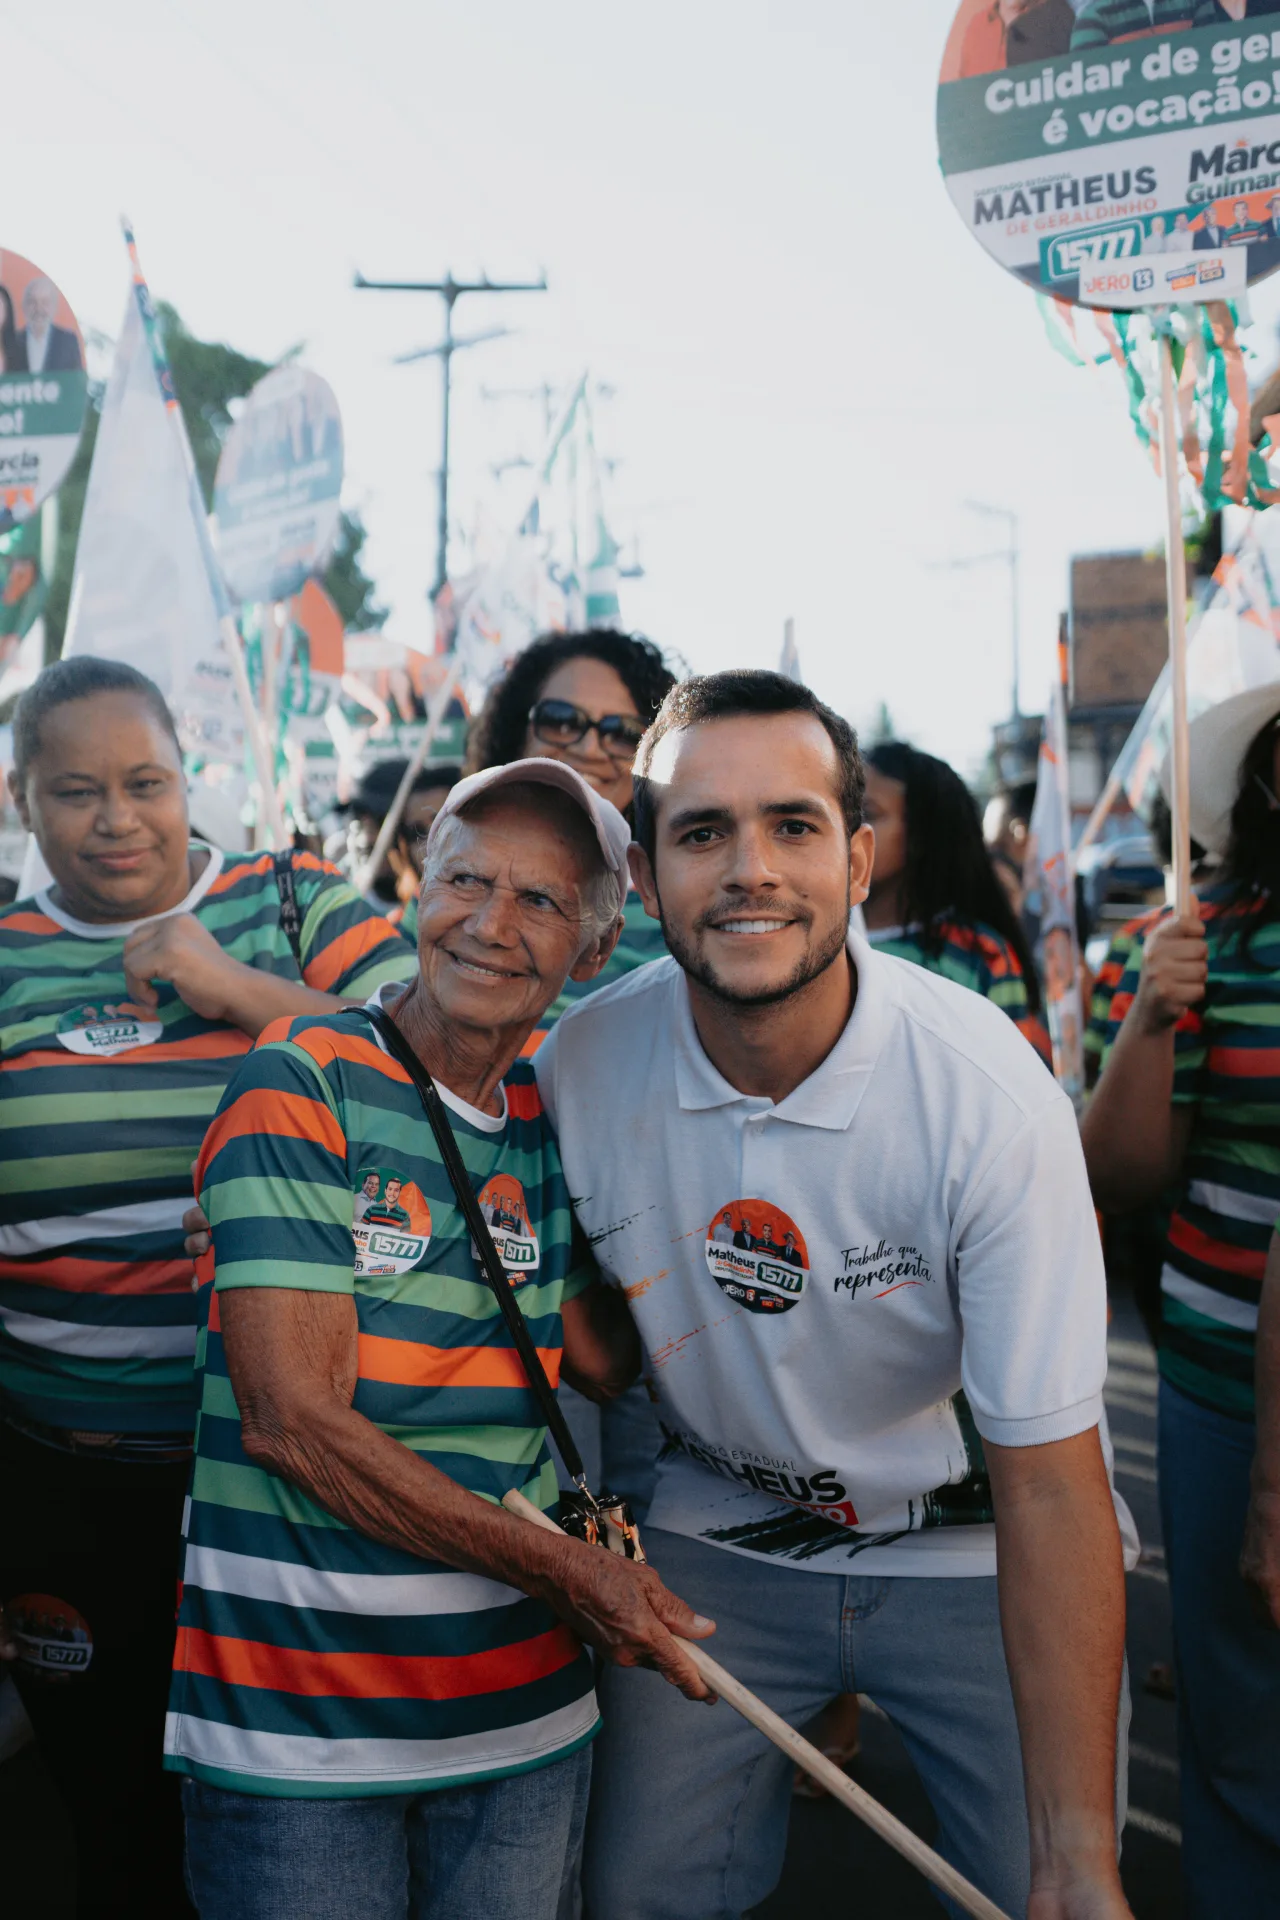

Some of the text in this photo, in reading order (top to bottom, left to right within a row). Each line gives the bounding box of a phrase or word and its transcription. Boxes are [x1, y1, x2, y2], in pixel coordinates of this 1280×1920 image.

[985, 58, 1131, 113] Cuidar
[1141, 43, 1199, 80] de
[1042, 70, 1280, 144] é vocação!
[974, 166, 1158, 225] MATHEUS
[1006, 198, 1158, 236] DE GERALDINHO
[374, 1234, 419, 1256] 15777
[708, 1247, 756, 1269] Matheus
[840, 1239, 918, 1271] Trabalho que
[760, 1263, 800, 1290] 15777
[834, 1253, 936, 1300] representa.
[731, 1450, 797, 1472] ESTADUAL
